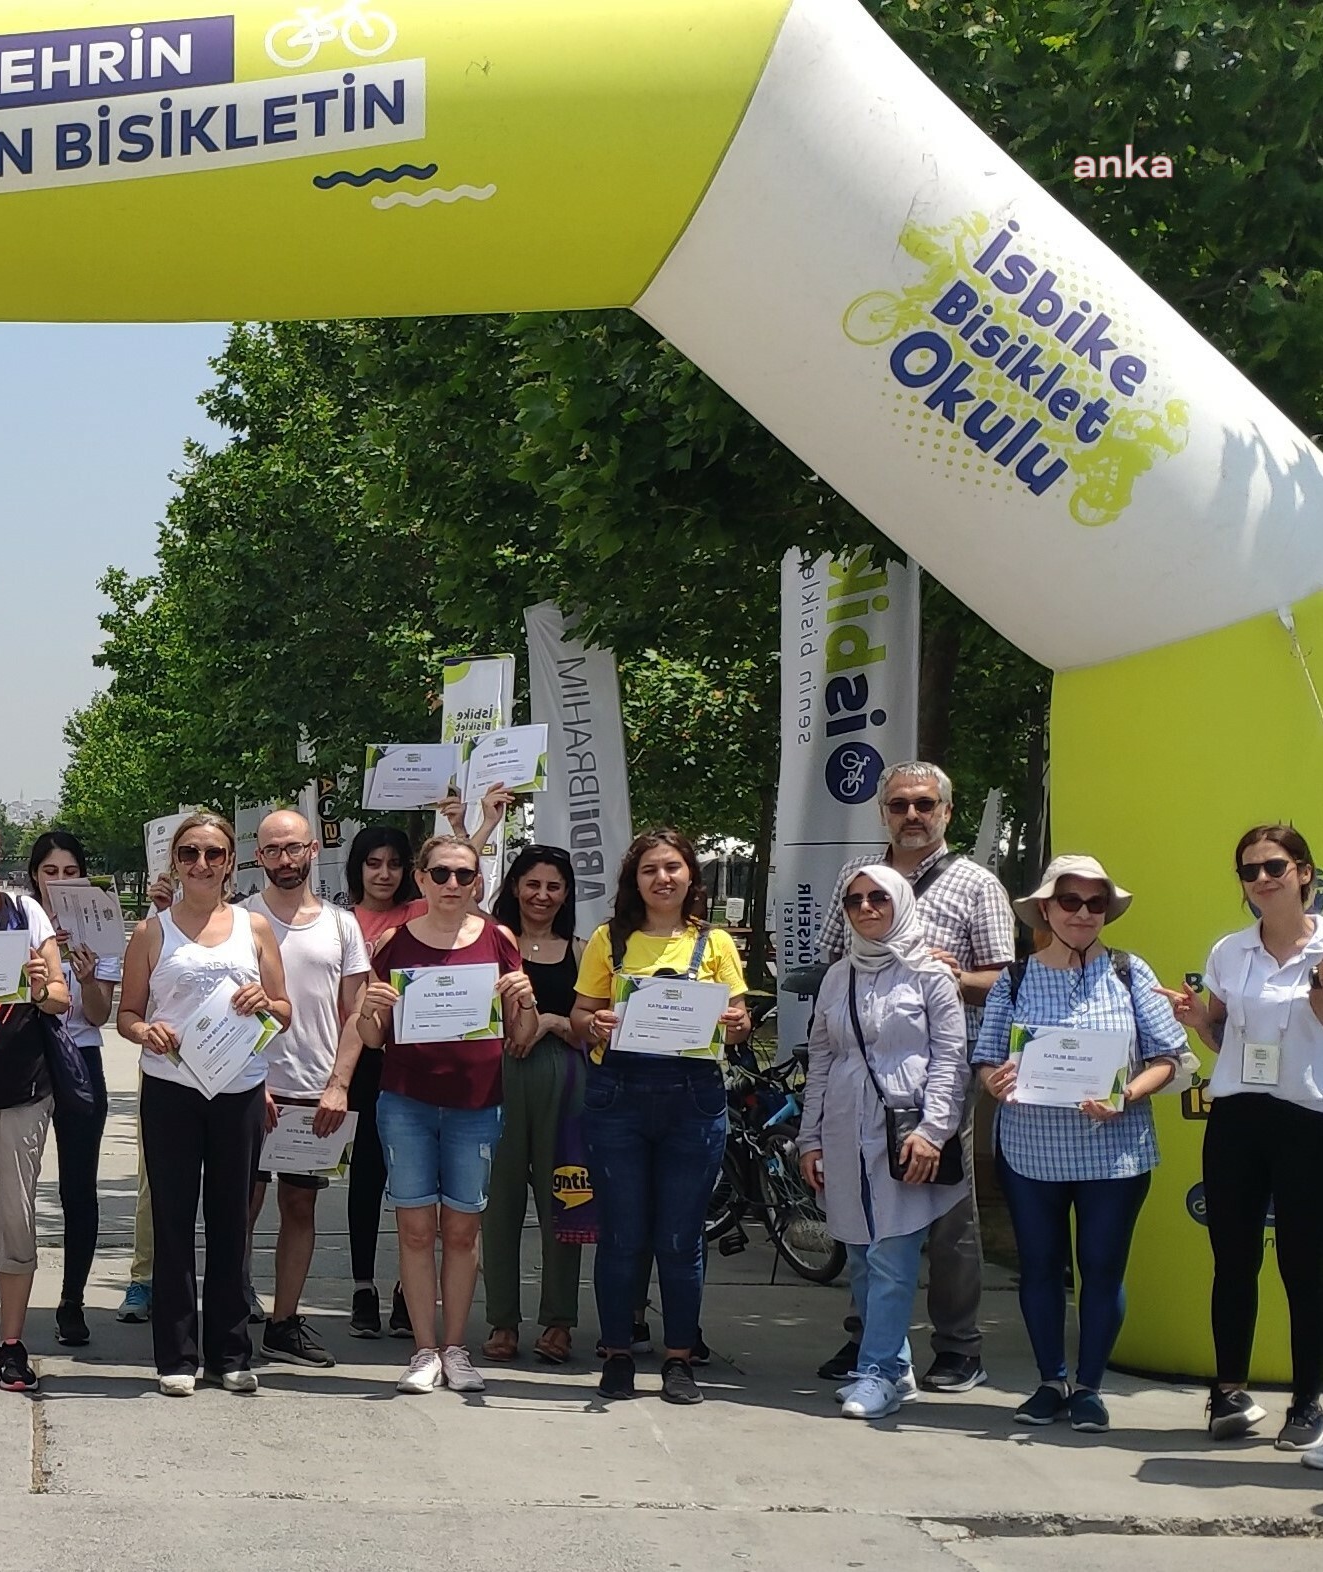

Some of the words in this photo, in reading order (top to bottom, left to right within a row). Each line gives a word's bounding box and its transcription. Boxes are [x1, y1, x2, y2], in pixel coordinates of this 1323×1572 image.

[55, 73, 406, 172] BİSİKLETİN
[889, 331, 1069, 498] Okulu
[930, 281, 1112, 444] Bisiklet
